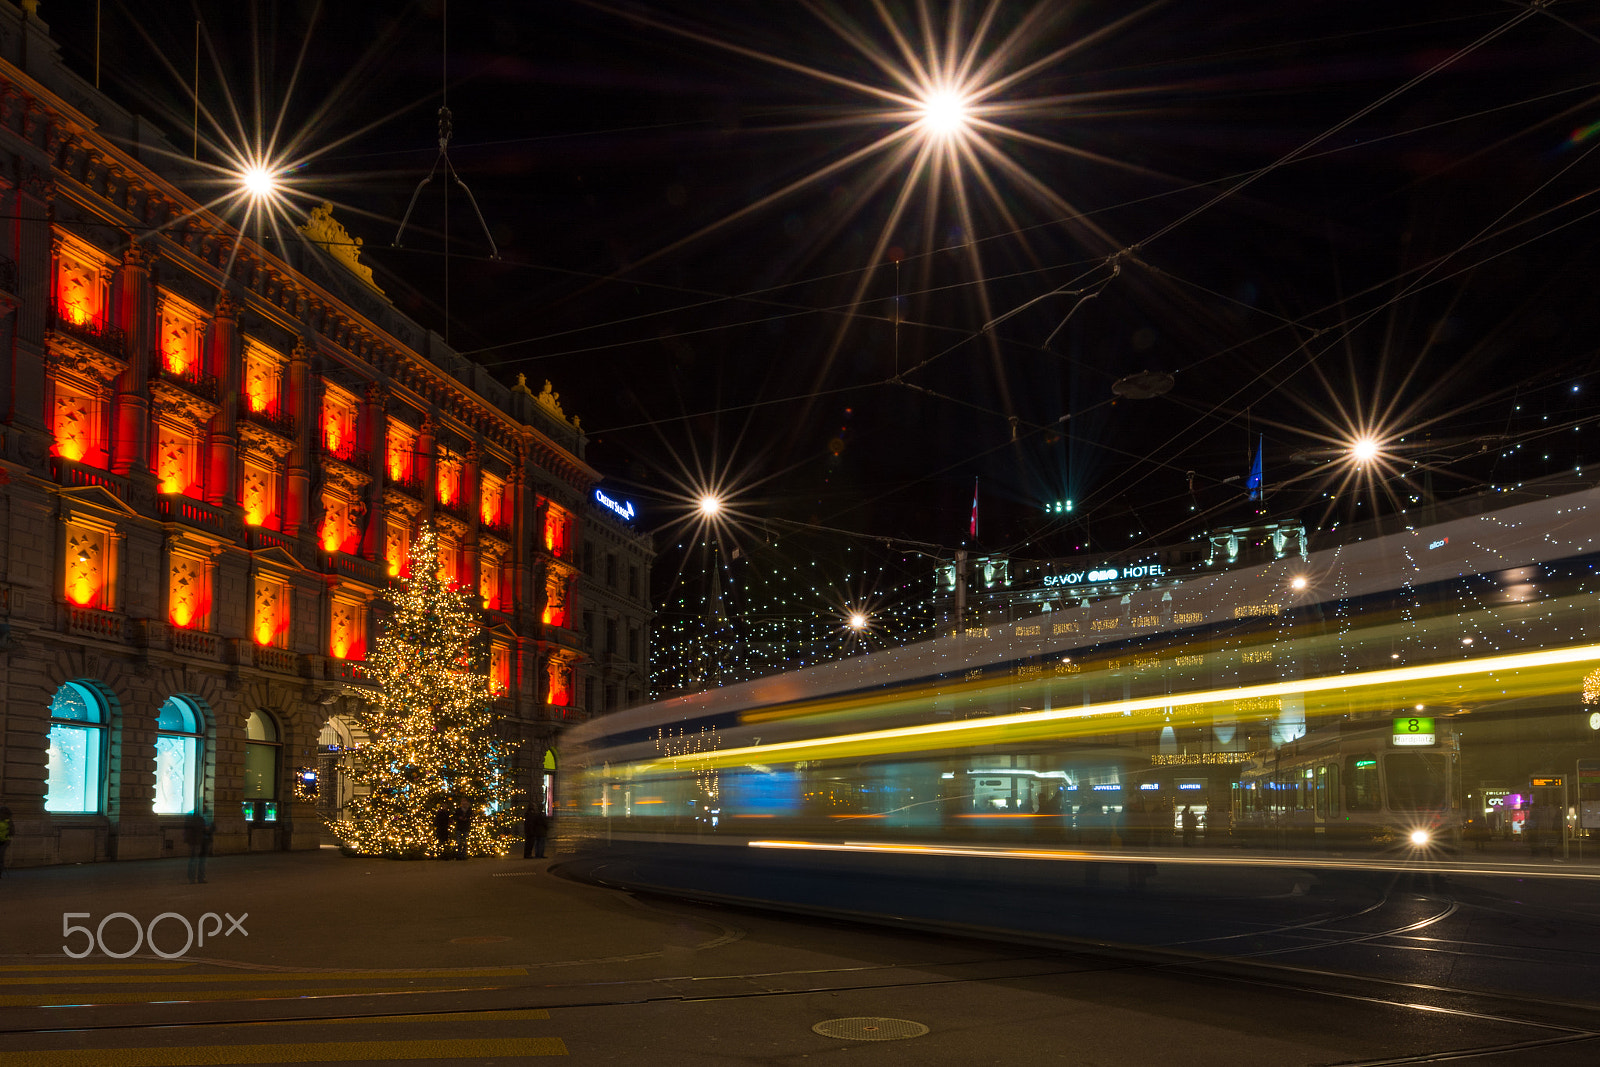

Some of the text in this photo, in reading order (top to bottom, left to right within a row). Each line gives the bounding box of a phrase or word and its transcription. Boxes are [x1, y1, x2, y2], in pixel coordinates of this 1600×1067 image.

[1043, 571, 1085, 586] SAVOY
[1123, 564, 1166, 579] HOTEL
[1408, 718, 1420, 732] 8
